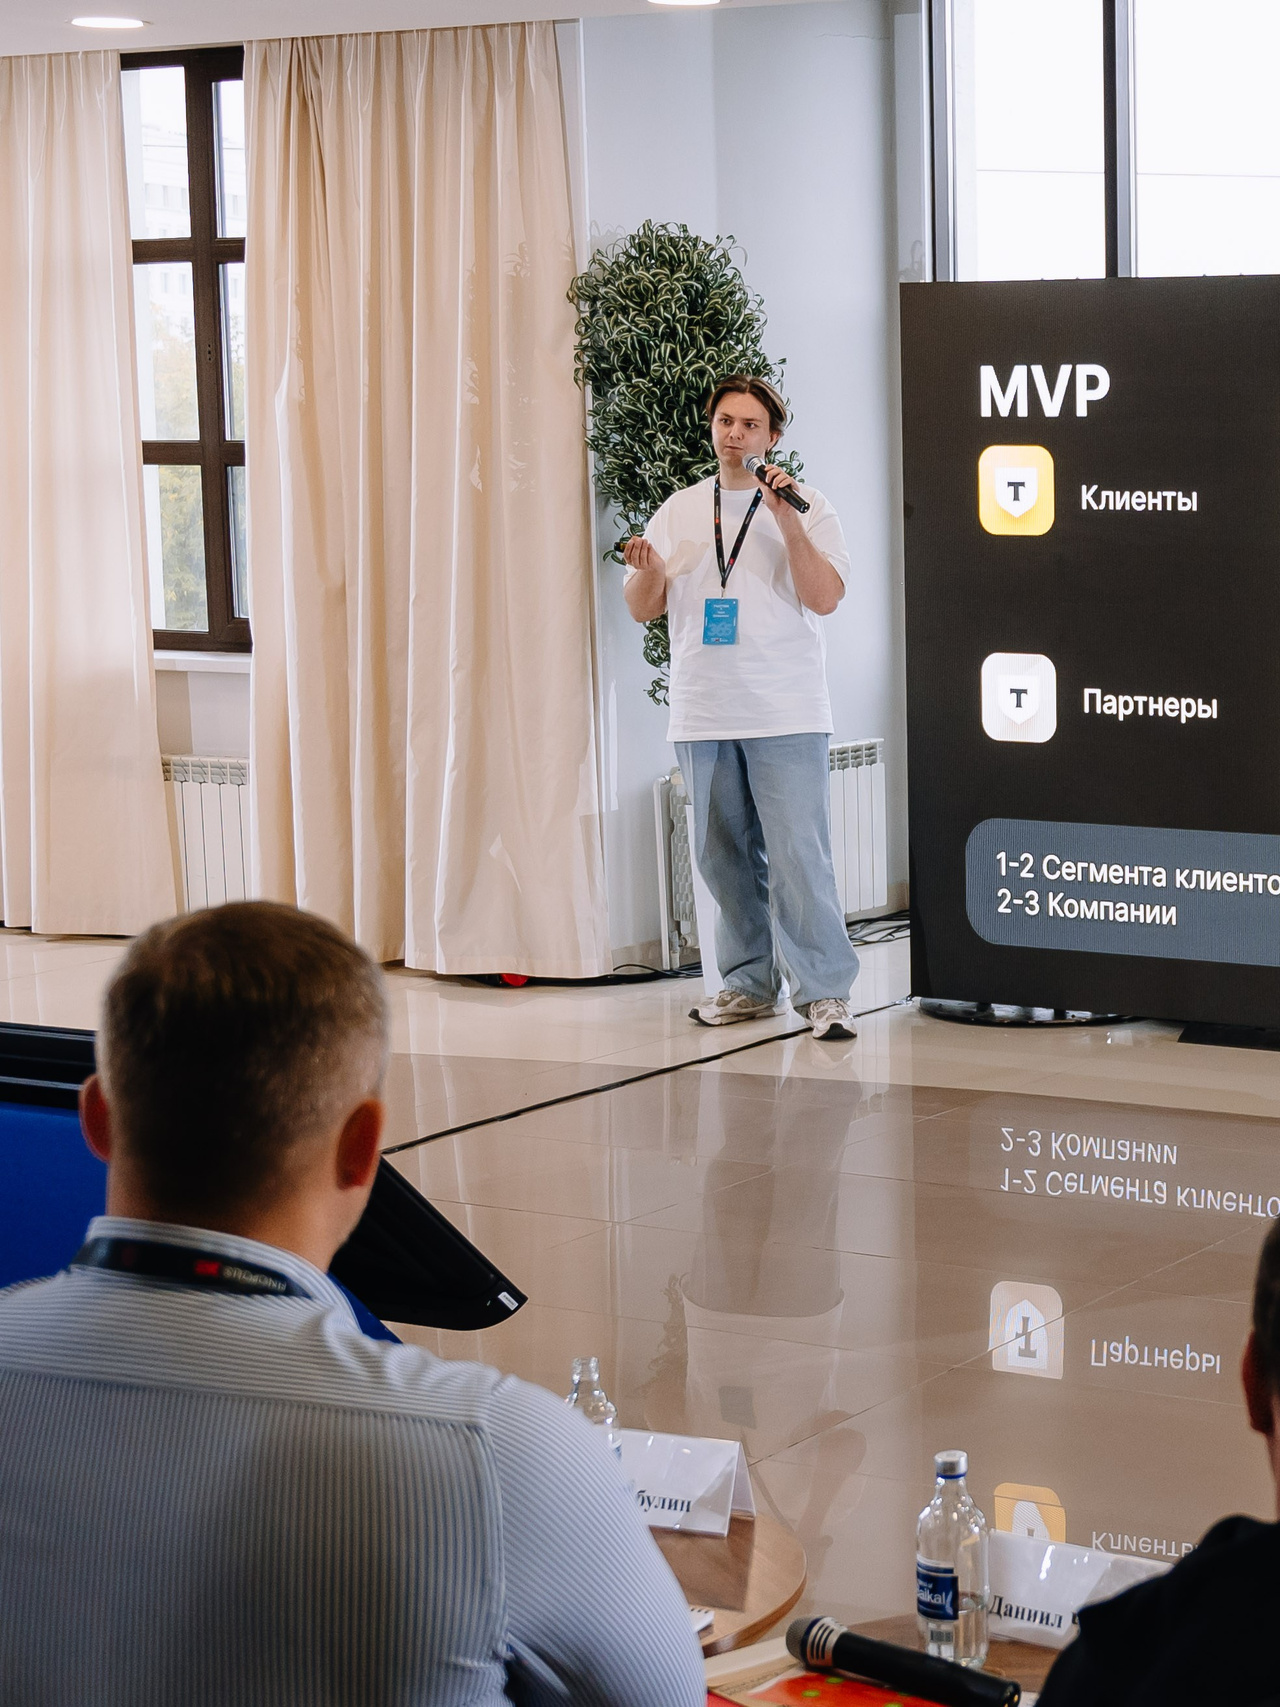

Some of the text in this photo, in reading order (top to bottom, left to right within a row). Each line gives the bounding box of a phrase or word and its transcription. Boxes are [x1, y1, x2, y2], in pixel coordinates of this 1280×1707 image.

[979, 363, 1111, 418] MVP
[1081, 484, 1198, 512] Клиенты
[1083, 687, 1218, 724] Партнеры
[996, 851, 1035, 879] 1-2
[1042, 854, 1167, 888] Сегмента
[997, 887, 1177, 926] 2-3 Компании
[637, 1490, 691, 1512] булин
[917, 1588, 946, 1605] aikal
[989, 1595, 1063, 1628] Даниил
